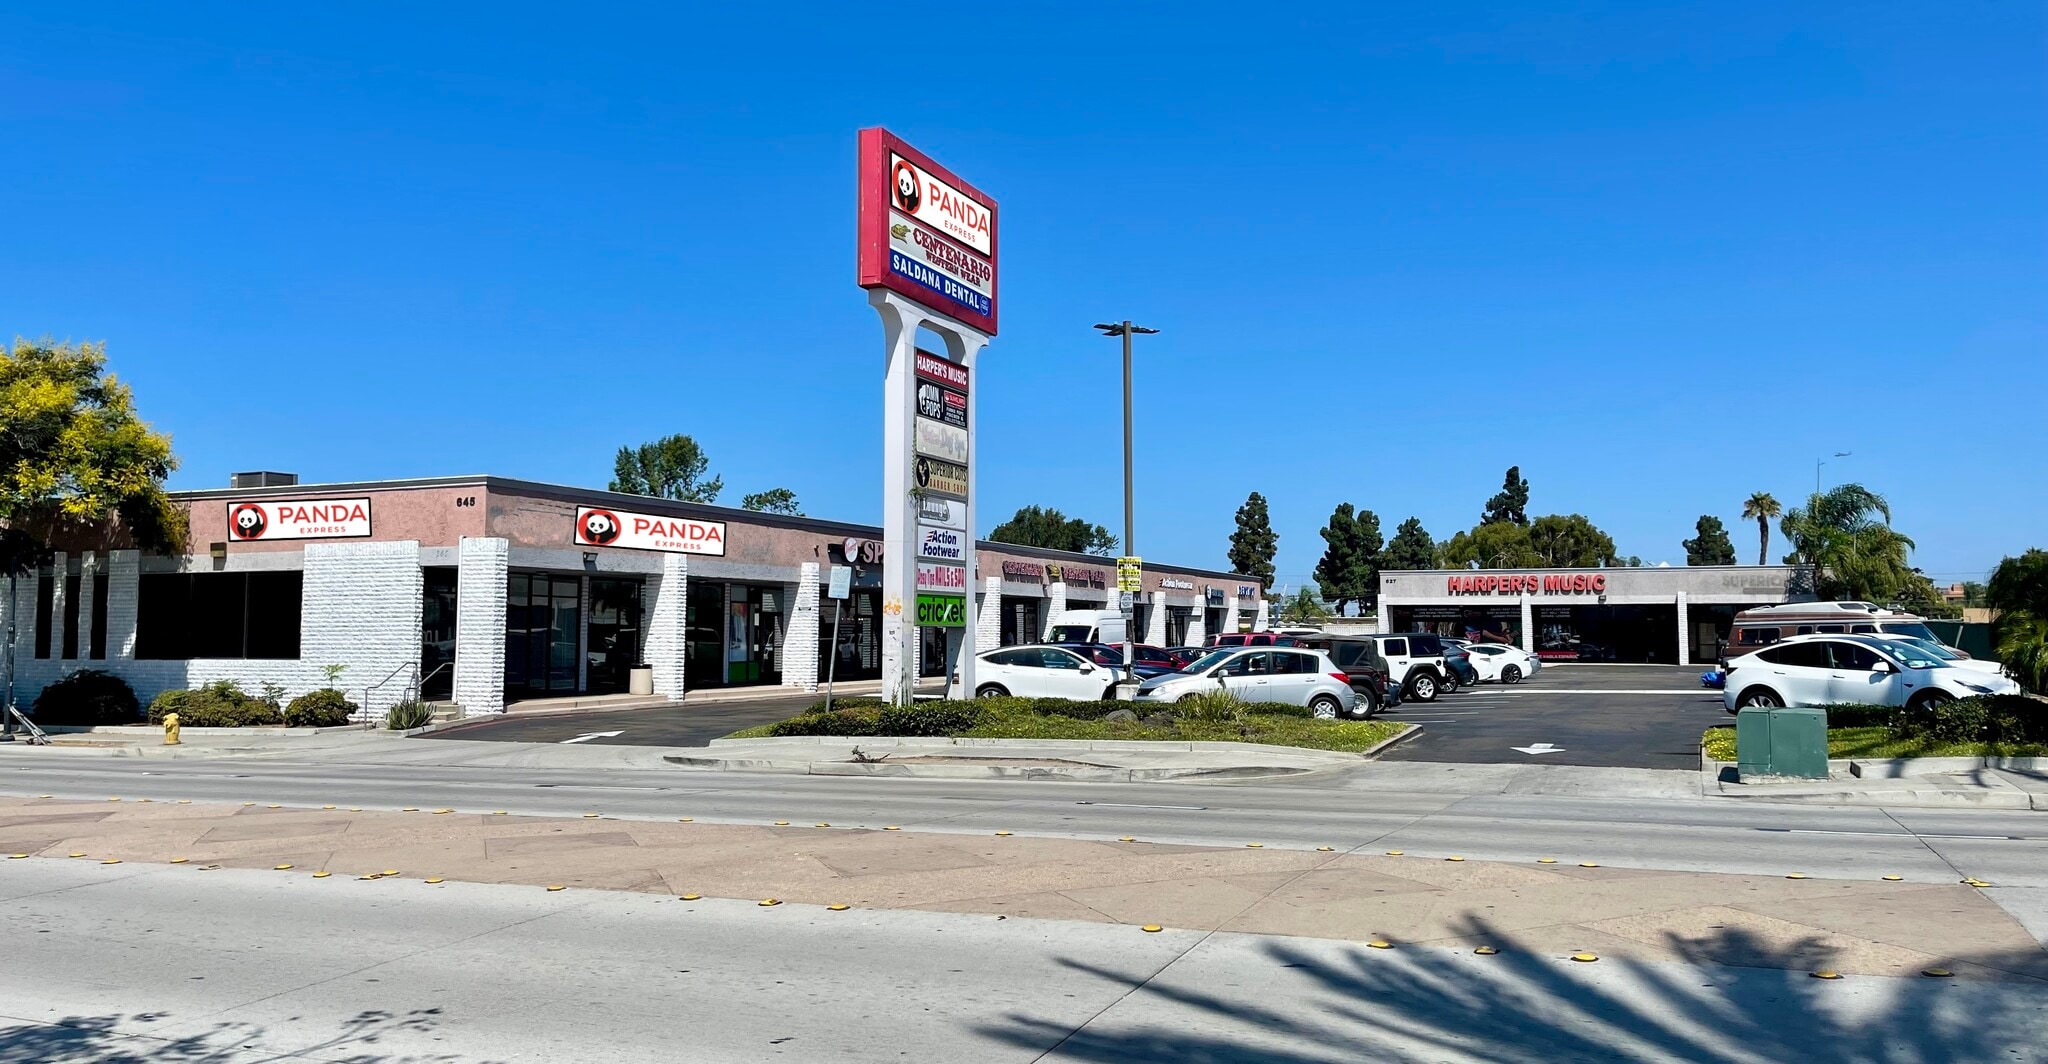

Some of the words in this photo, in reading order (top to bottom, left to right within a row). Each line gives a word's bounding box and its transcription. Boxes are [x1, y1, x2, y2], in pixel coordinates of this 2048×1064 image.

[929, 182, 989, 237] PANDA
[944, 220, 976, 243] EXPRESS
[912, 227, 991, 282] CENTENARIO
[925, 251, 959, 276] WESTERN
[959, 267, 981, 288] WEAR
[893, 254, 940, 290] SALDANA
[945, 280, 979, 310] DENTAL
[917, 355, 947, 379] HARPER'S
[948, 367, 967, 385] MUSIC
[926, 400, 940, 419] POPS
[930, 479, 950, 491] BARBER
[954, 484, 966, 494] SHOP
[457, 497, 475, 507] 645
[278, 504, 367, 524] PANDA
[300, 526, 346, 534] EXPRESS
[633, 518, 722, 542] PANDA
[932, 530, 957, 545] Action
[655, 540, 701, 550] EXPRESS
[863, 541, 884, 563] SP
[923, 543, 960, 558] Footwear
[955, 567, 964, 587] SPA
[1448, 575, 1538, 592] HARPER'S
[1544, 575, 1605, 592] MUSIC
[918, 597, 965, 622] cricket
